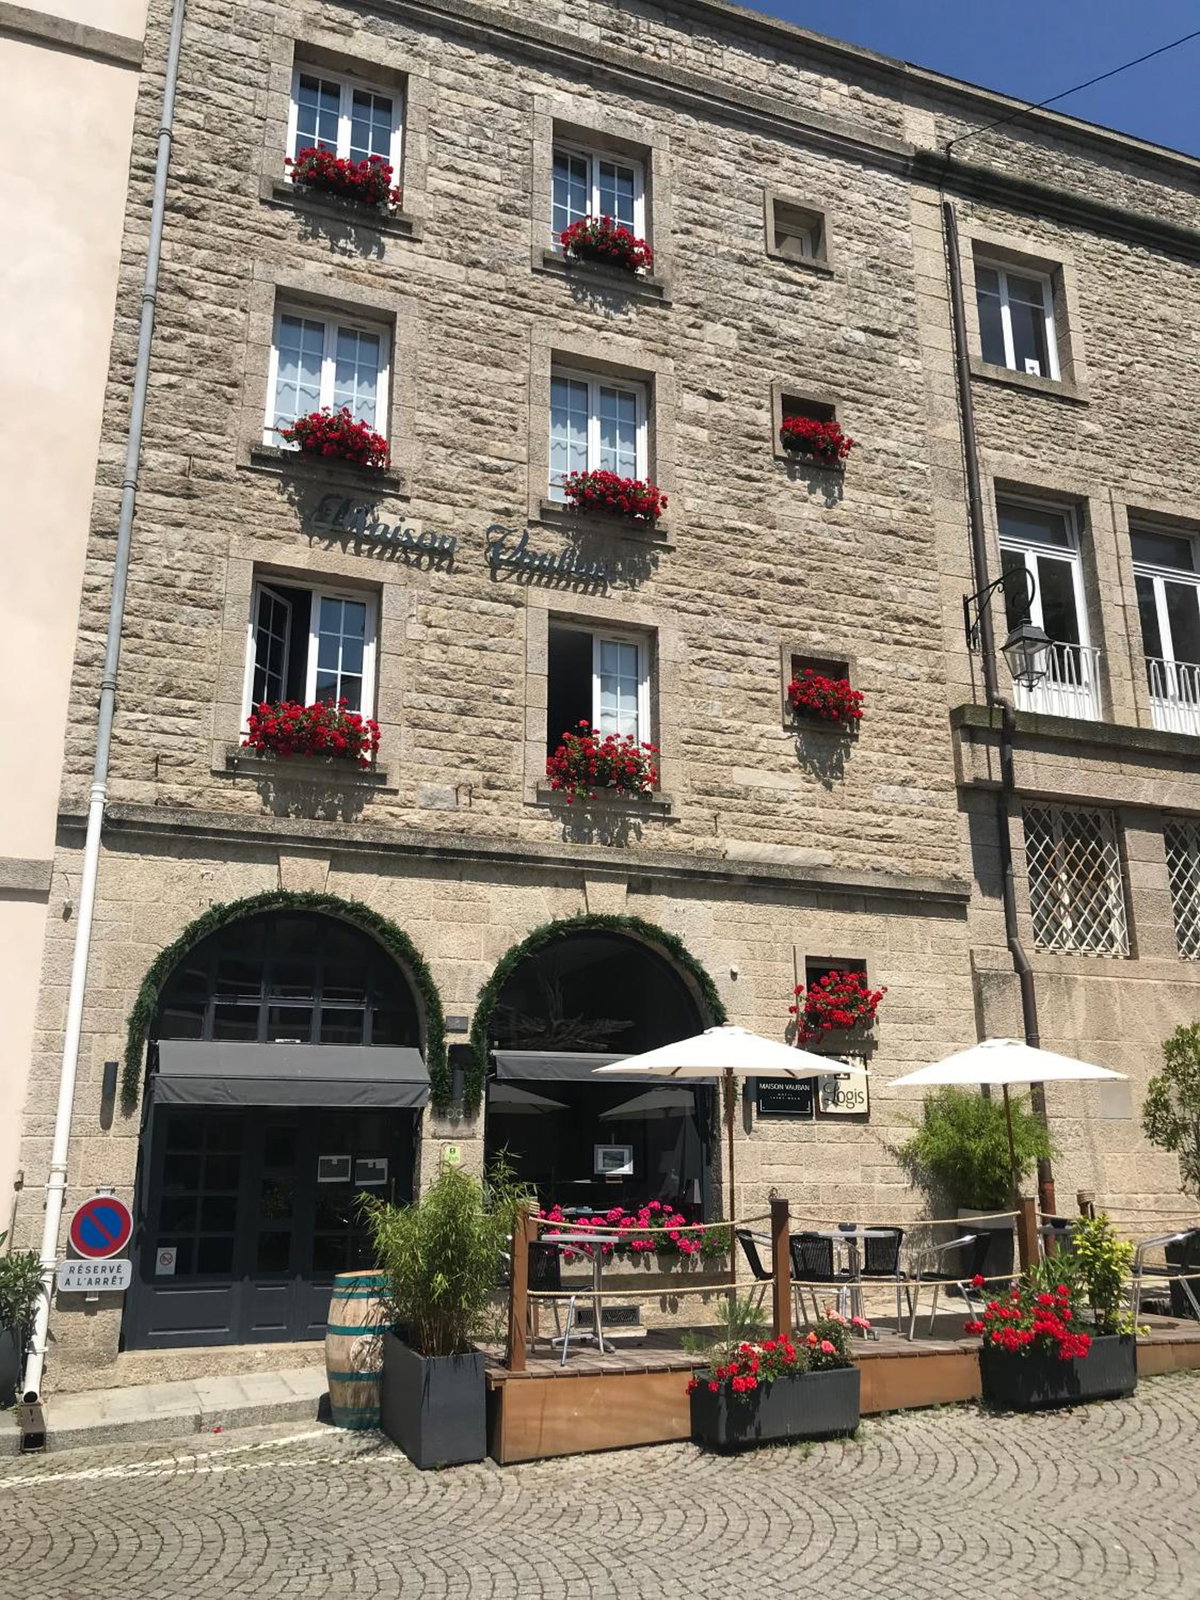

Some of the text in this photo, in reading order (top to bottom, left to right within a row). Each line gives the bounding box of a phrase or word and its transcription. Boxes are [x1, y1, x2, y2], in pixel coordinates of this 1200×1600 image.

[311, 493, 457, 555] Maison
[759, 1083, 784, 1091] MAISON
[69, 1264, 122, 1274] RÉSERVÉ
[65, 1276, 124, 1286] A L'ARRÊT
